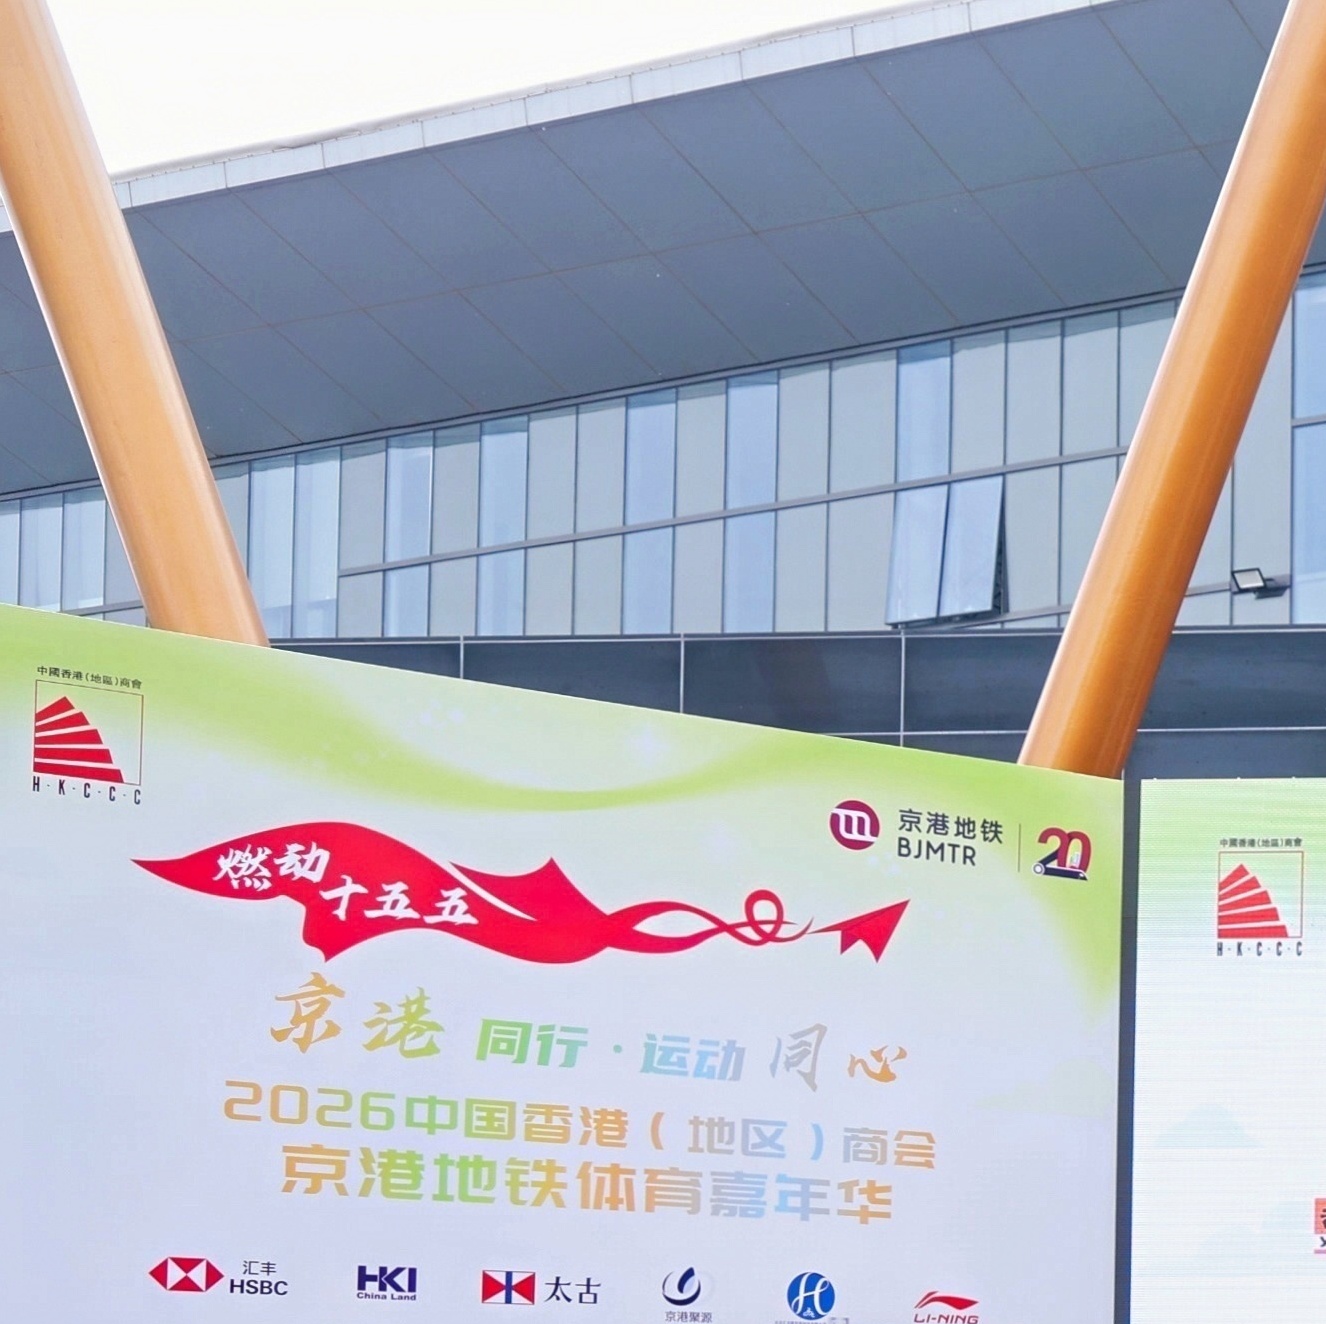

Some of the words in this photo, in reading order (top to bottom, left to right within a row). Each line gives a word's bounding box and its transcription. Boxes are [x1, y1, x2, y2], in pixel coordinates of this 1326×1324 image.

[897, 807, 1004, 844] 京港地铁
[897, 838, 977, 867] BJMTR
[280, 1143, 893, 1226] 京港地铁体育嘉年华
[242, 1260, 277, 1276] 汇丰
[356, 1265, 417, 1293] HKI
[229, 1279, 289, 1297] HSBC
[356, 1292, 388, 1300] China
[390, 1293, 417, 1301] Land
[544, 1275, 602, 1305] 太古
[664, 1311, 713, 1324] 京港聚源
